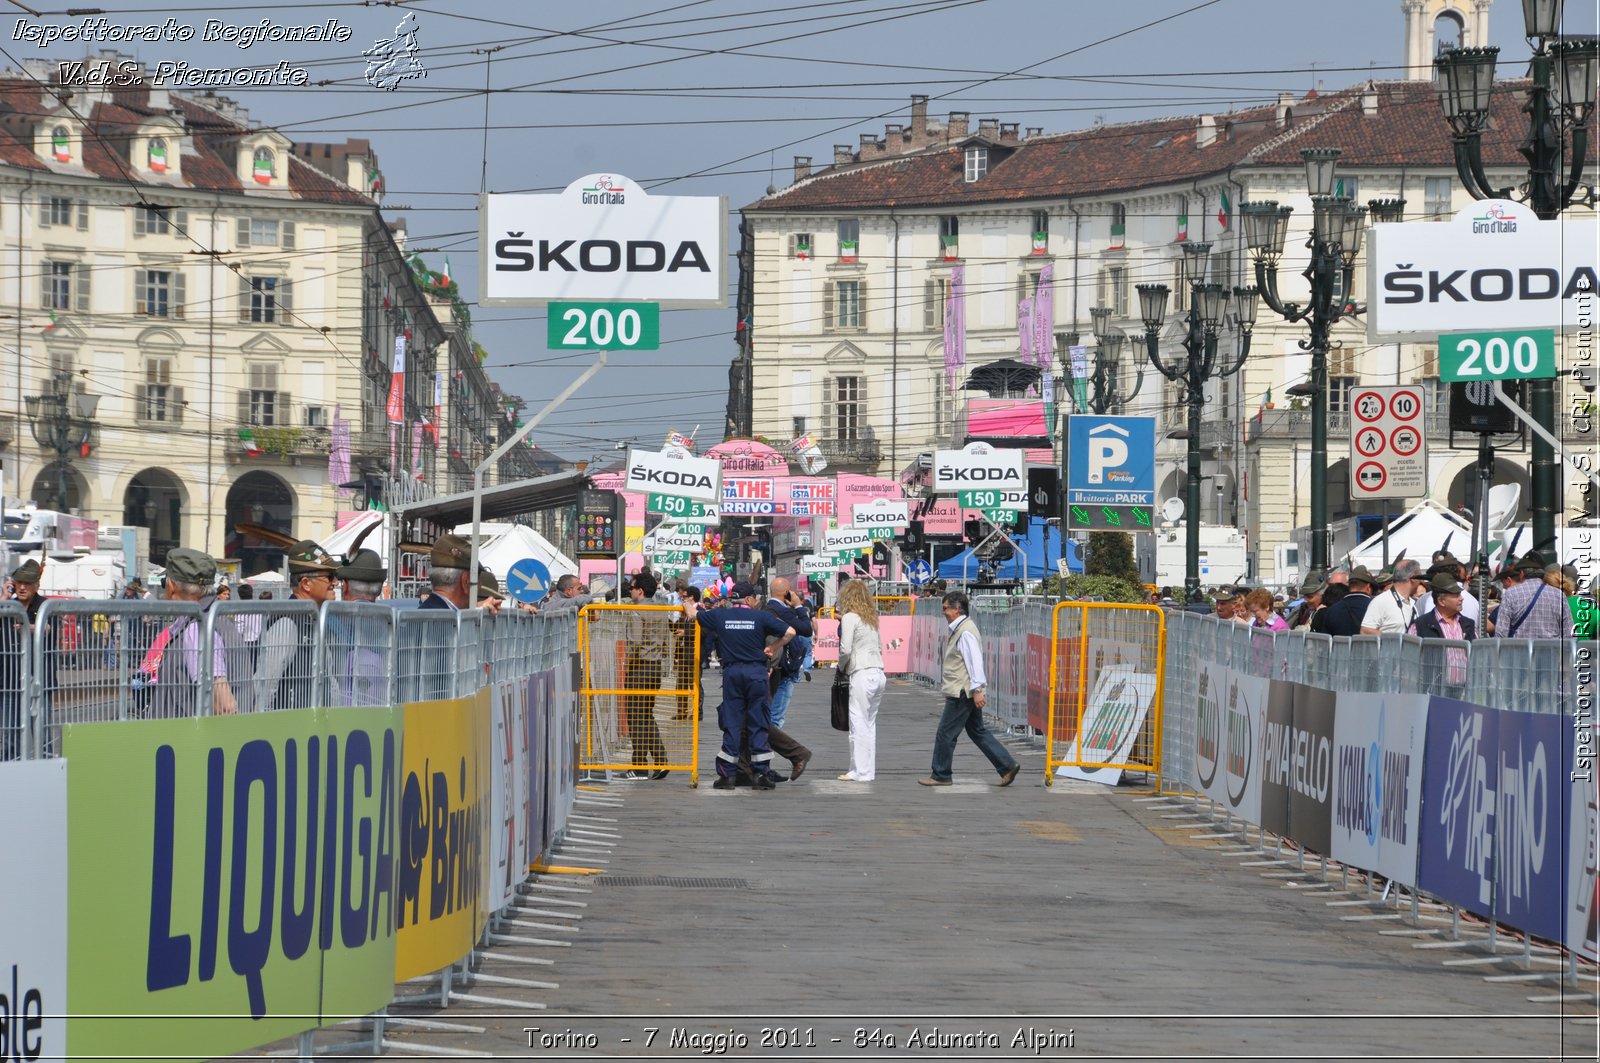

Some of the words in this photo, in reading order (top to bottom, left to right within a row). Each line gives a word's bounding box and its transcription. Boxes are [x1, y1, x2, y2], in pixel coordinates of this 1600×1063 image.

[582, 192, 599, 205] Giro
[599, 191, 625, 206] d'Italia
[1473, 220, 1489, 234] Giro
[1490, 219, 1517, 234] d'Italia
[495, 231, 712, 273] ŠKODA
[1384, 263, 1600, 304] ŠKODA
[562, 308, 642, 346] 200
[1456, 335, 1539, 376] 200
[1398, 399, 1412, 413] 10
[1088, 437, 1129, 484] P
[631, 465, 713, 489] ŠKODA
[939, 465, 1020, 481] ŠKODA
[736, 480, 770, 499] THE
[792, 490, 809, 498] ESTA
[808, 485, 833, 498] THE
[654, 495, 685, 513] 150
[965, 491, 995, 506] 150
[999, 493, 1029, 502] ODA
[792, 506, 809, 515] ESTA
[808, 501, 833, 515] THE
[856, 512, 906, 523] ŠKODA
[990, 510, 1014, 522] 125
[683, 524, 701, 534] 100
[871, 528, 891, 538] 100
[673, 551, 684, 560] 75
[844, 549, 856, 558] 75
[1264, 721, 1332, 804] PINARELLO
[1336, 745, 1366, 841] ACQUA
[1381, 749, 1410, 846] SAPONE
[1464, 712, 1548, 914] TRENTINO
[146, 728, 402, 1021] LIQUIGA
